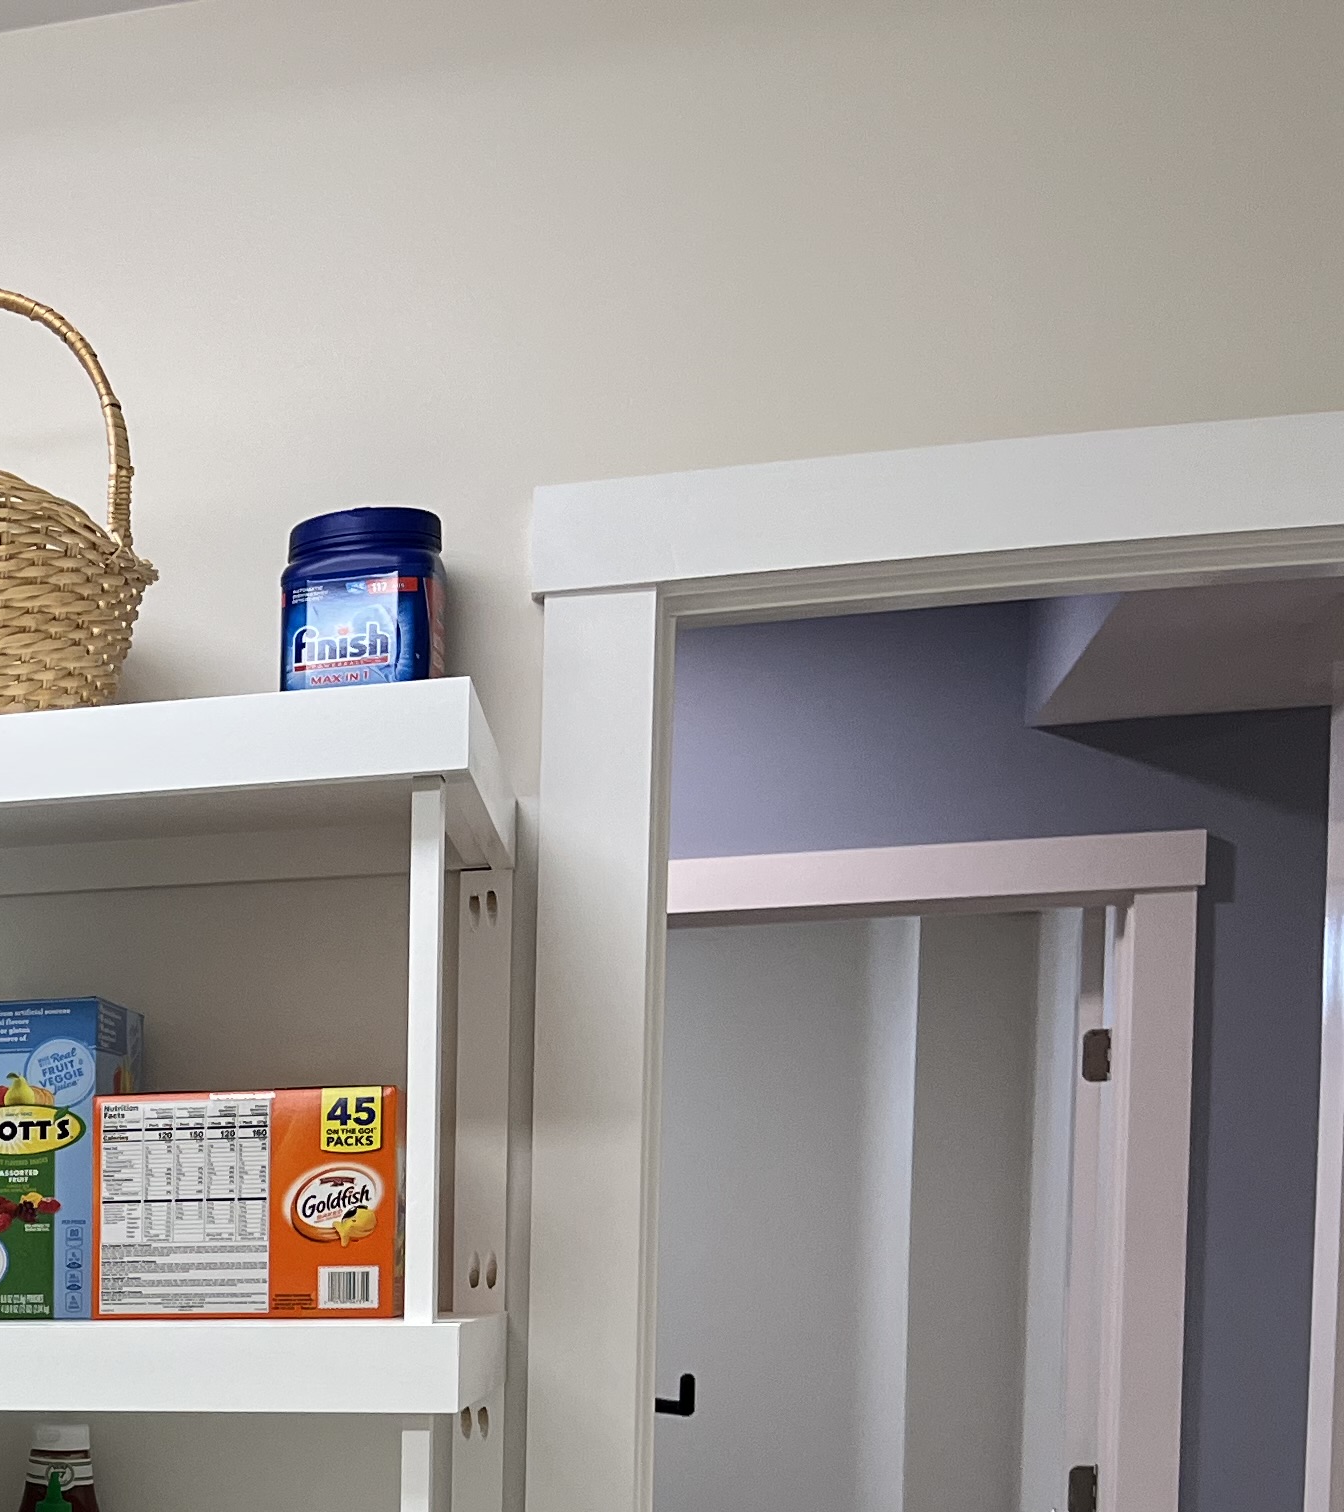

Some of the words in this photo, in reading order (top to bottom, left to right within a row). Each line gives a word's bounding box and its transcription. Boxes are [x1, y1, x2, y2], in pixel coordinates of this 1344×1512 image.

[293, 622, 390, 665] finish
[311, 673, 343, 685] MAX
[344, 671, 358, 681] IN
[363, 671, 369, 680] 1
[50, 1046, 78, 1063] Real
[41, 1059, 75, 1079] FRUIT
[38, 1067, 85, 1088] VEGGIE
[103, 1104, 139, 1112] Nutrition
[326, 1096, 377, 1127] 45
[103, 1112, 126, 1120] Facts
[158, 1131, 173, 1140] 120
[220, 1129, 236, 1138] 120
[341, 1127, 356, 1135] THE
[357, 1127, 374, 1135] GO!
[326, 1134, 375, 1148] PACKS
[301, 1183, 371, 1220] Goldfish
